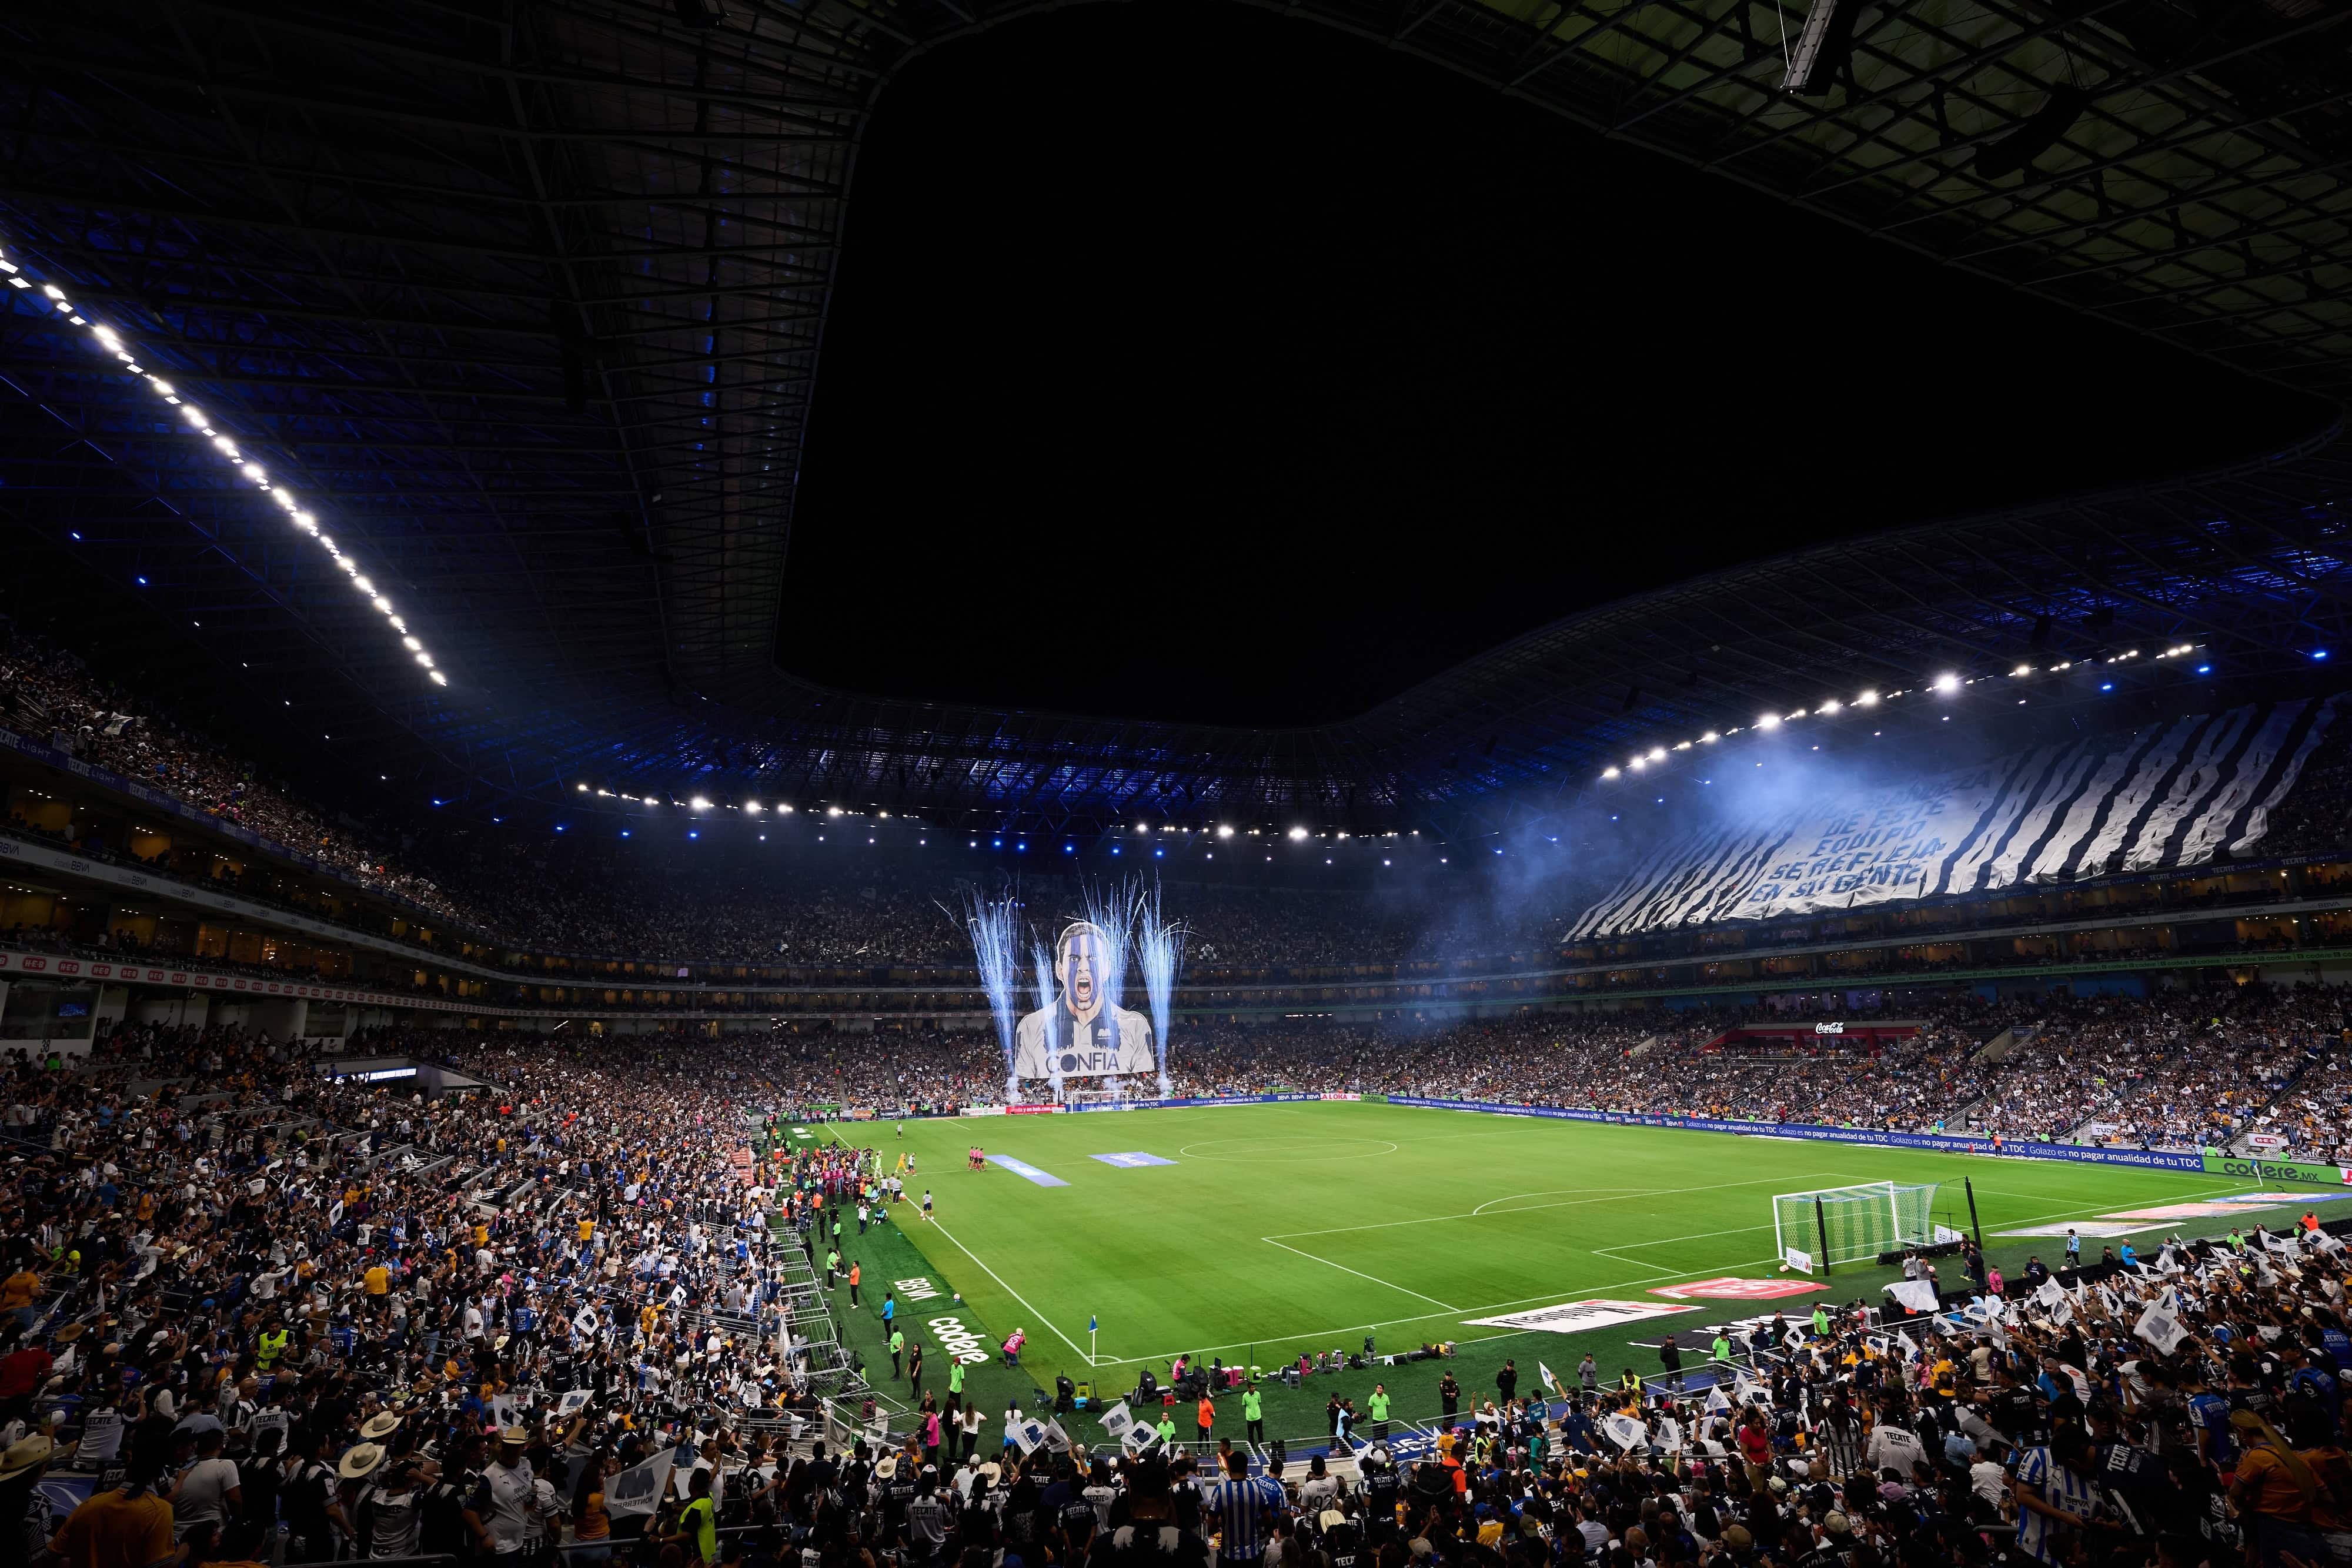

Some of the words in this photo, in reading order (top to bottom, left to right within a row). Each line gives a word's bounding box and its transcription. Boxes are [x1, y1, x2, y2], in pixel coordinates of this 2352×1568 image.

[0, 731, 20, 748] CATE
[21, 739, 51, 758] LIGHT
[67, 757, 91, 777] TECATE
[92, 766, 116, 785] LIGHT
[129, 783, 148, 800] TECATE
[149, 791, 170, 807] LIGHT
[1823, 813, 1864, 837] DE
[1867, 800, 1947, 828] ESTE
[1809, 821, 1928, 857] EQUIPO
[1769, 862, 1810, 881] SE
[1808, 837, 1947, 876] REFLEJA
[2281, 857, 2307, 865] TECATE
[71, 858, 90, 873] BBVA
[2211, 865, 2234, 874] TECATE
[132, 875, 148, 887] BBVA
[1750, 882, 1790, 902] EN
[1789, 880, 1826, 898] SU
[1830, 863, 1923, 892] GENTE
[182, 888, 195, 898] BBVA
[1815, 1022, 1845, 1034] Coca-Cola
[40, 1039, 51, 1053] 38
[1728, 1124, 1752, 1132] anualidad
[1829, 1132, 1857, 1140] anualidad
[1891, 1135, 1912, 1145] Golazo
[1932, 1140, 1951, 1149] pagar
[1952, 1141, 1988, 1151] anualidad
[2009, 1145, 2025, 1153] TDC
[2029, 1146, 2056, 1156] Golazo
[2069, 1150, 2080, 1158] no
[2082, 1151, 2105, 1163] pagar
[2107, 1152, 2151, 1164] anualidad
[2152, 1154, 2163, 1165] de
[2165, 1156, 2177, 1166] tu
[2180, 1157, 2201, 1169] TDC
[2223, 1162, 2320, 1182] codere.MX
[1790, 1257, 1804, 1268] BBVA
[894, 1277, 942, 1302] BBVA
[928, 1317, 990, 1365] codere
[2324, 1334, 2346, 1343] TECATE
[2013, 1396, 2030, 1405] TECATE
[2246, 1393, 2269, 1404] TECATE
[2204, 1401, 2224, 1412] TECATE
[85, 1417, 112, 1425] TECATE
[255, 1415, 280, 1423] TECATE
[1782, 1412, 1796, 1420] TECATE
[1884, 1432, 1911, 1444] TECATE
[2107, 1444, 2132, 1472] TECATE
[1374, 1476, 1392, 1484] TECATE
[890, 1485, 916, 1495] TECATE
[2064, 1495, 2090, 1509] BBVA
[912, 1506, 938, 1515] TECATE
[1065, 1505, 1087, 1516] TECATE
